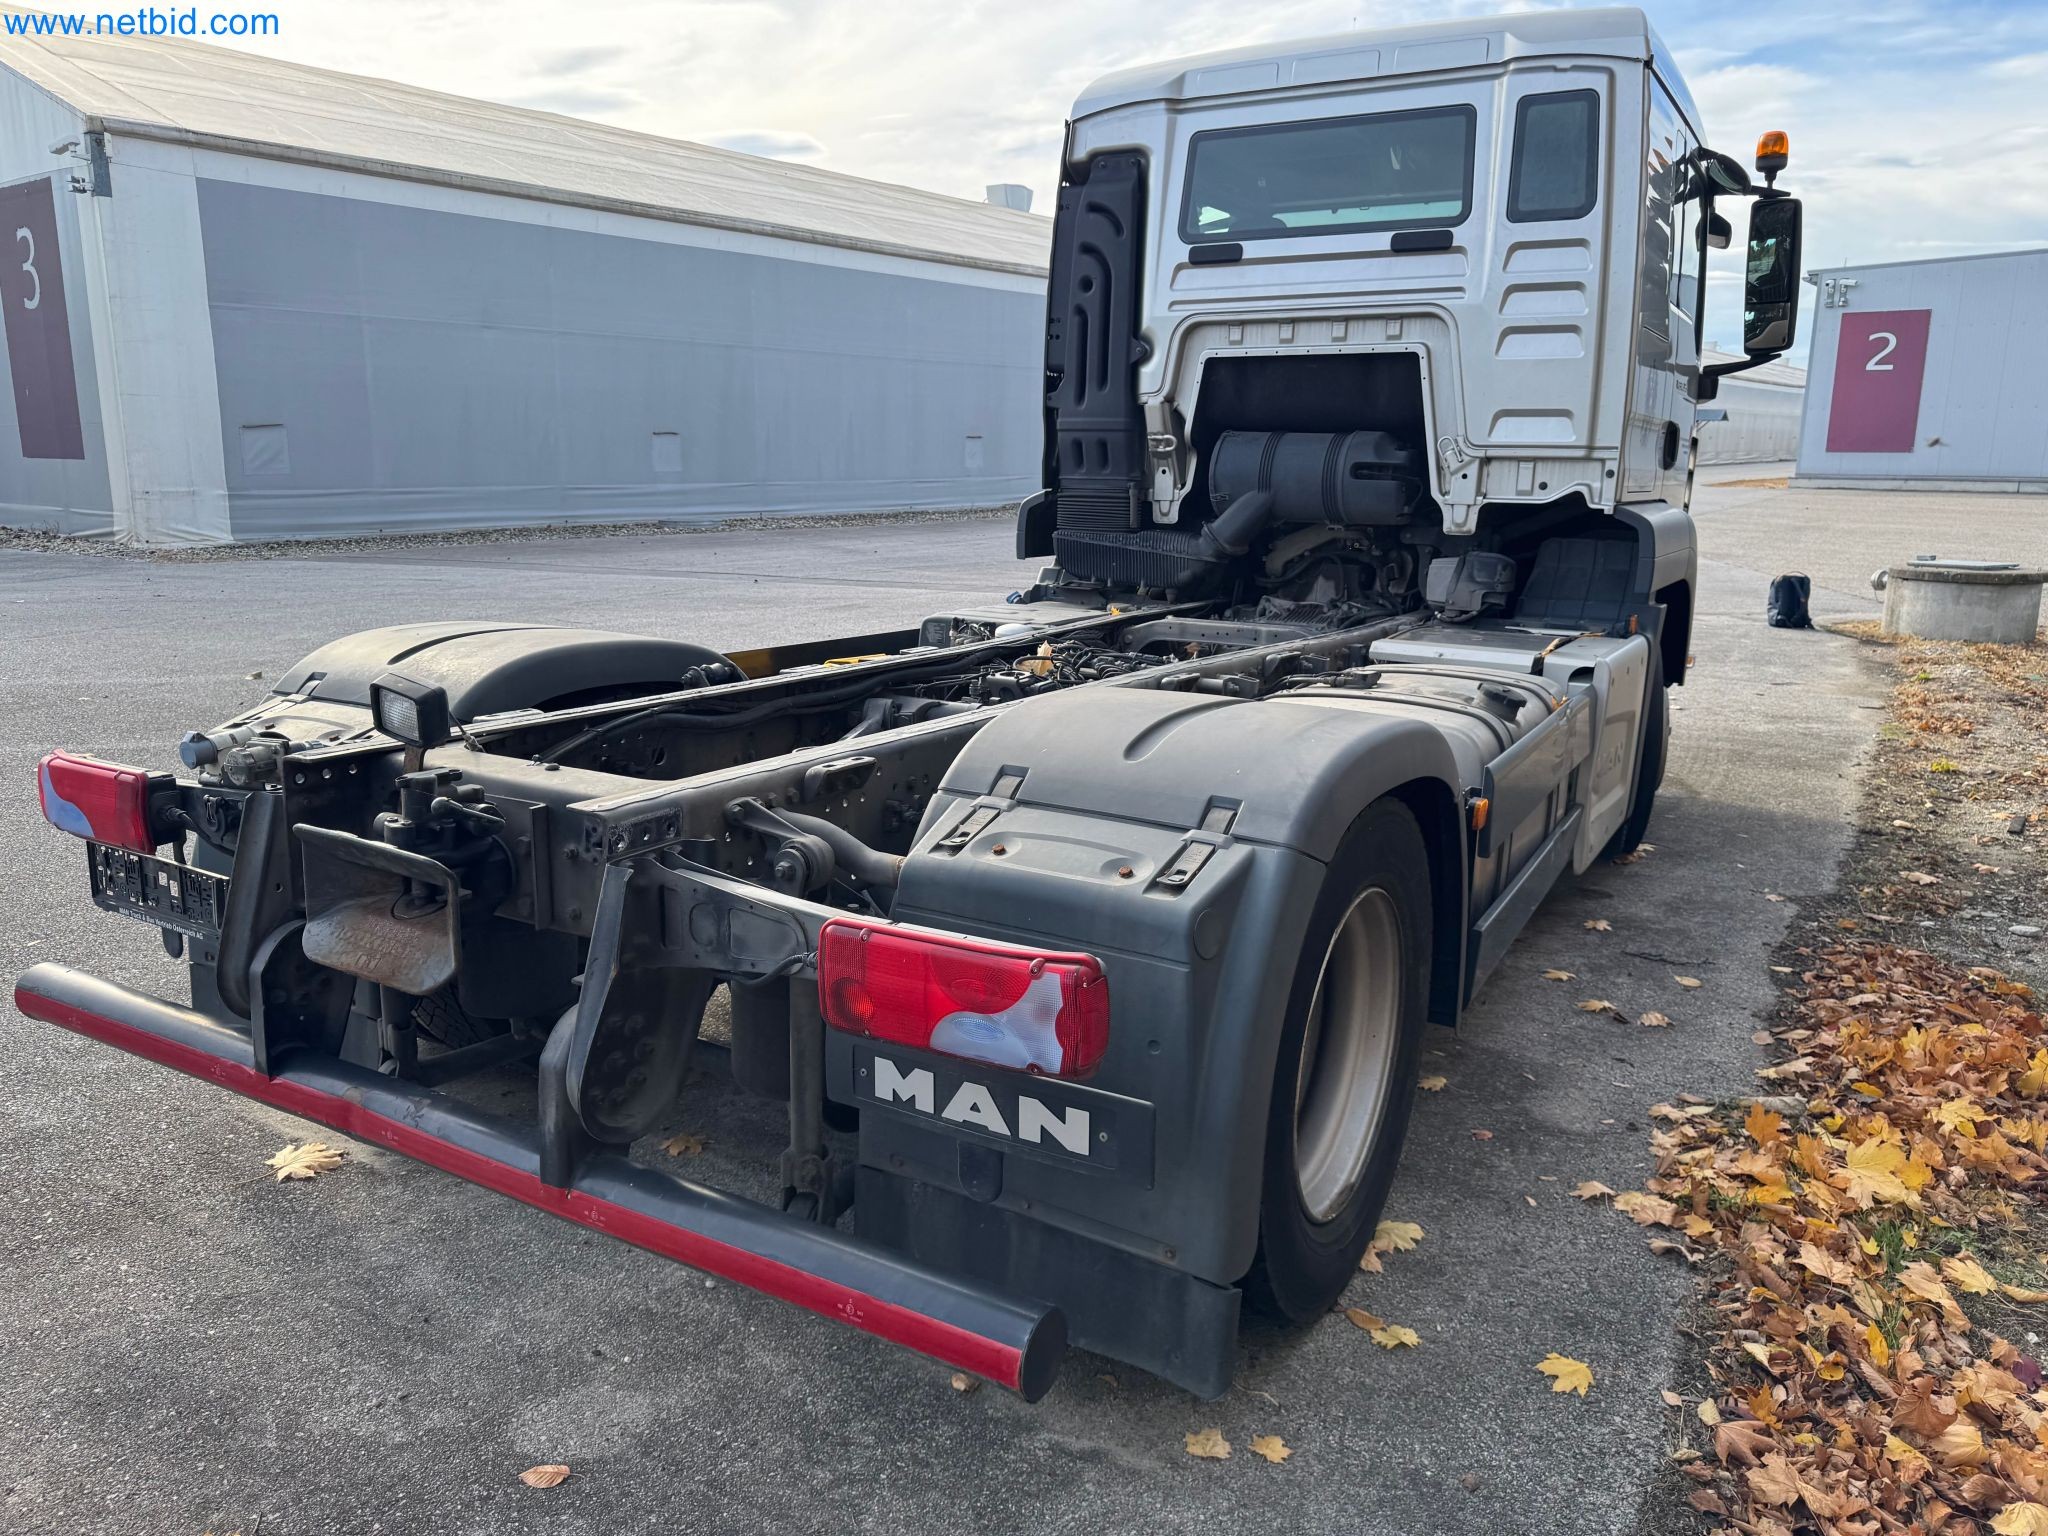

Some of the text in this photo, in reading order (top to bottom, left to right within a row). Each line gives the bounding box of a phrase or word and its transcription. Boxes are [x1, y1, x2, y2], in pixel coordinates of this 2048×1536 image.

[16, 225, 41, 310] 3
[1865, 332, 1897, 371] 2
[130, 910, 141, 920] Truck
[874, 1056, 1090, 1156] MAN
